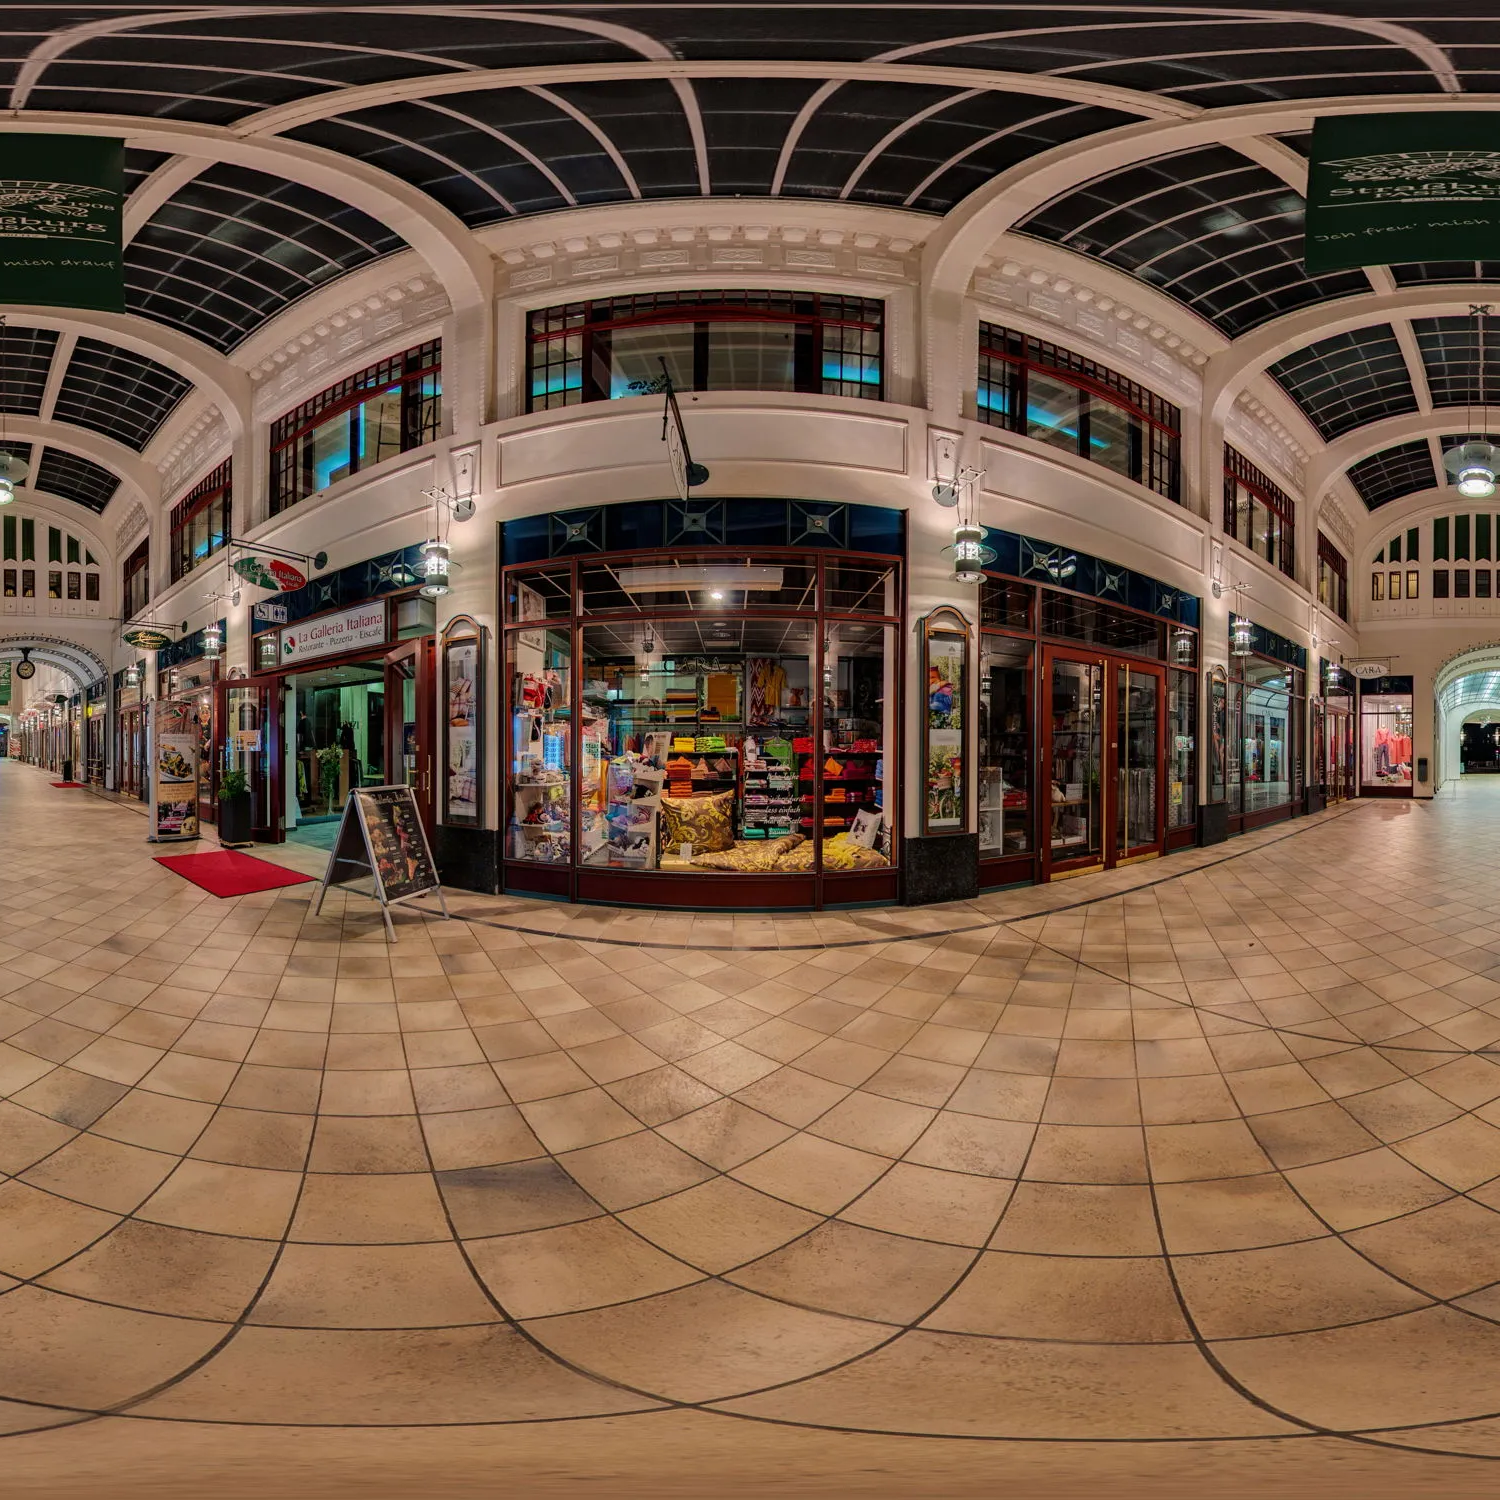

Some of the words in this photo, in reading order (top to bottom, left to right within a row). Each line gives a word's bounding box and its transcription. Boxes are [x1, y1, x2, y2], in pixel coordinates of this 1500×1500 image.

[4, 258, 55, 267] mich
[61, 258, 116, 269] drauf
[298, 632, 308, 643] La
[310, 622, 344, 639] Galleria
[347, 614, 383, 631] Italiana
[299, 641, 324, 653] Ristorante
[329, 635, 353, 647] Pizzeria
[360, 626, 383, 639] Eiscafé
[1355, 666, 1382, 675] CARA
